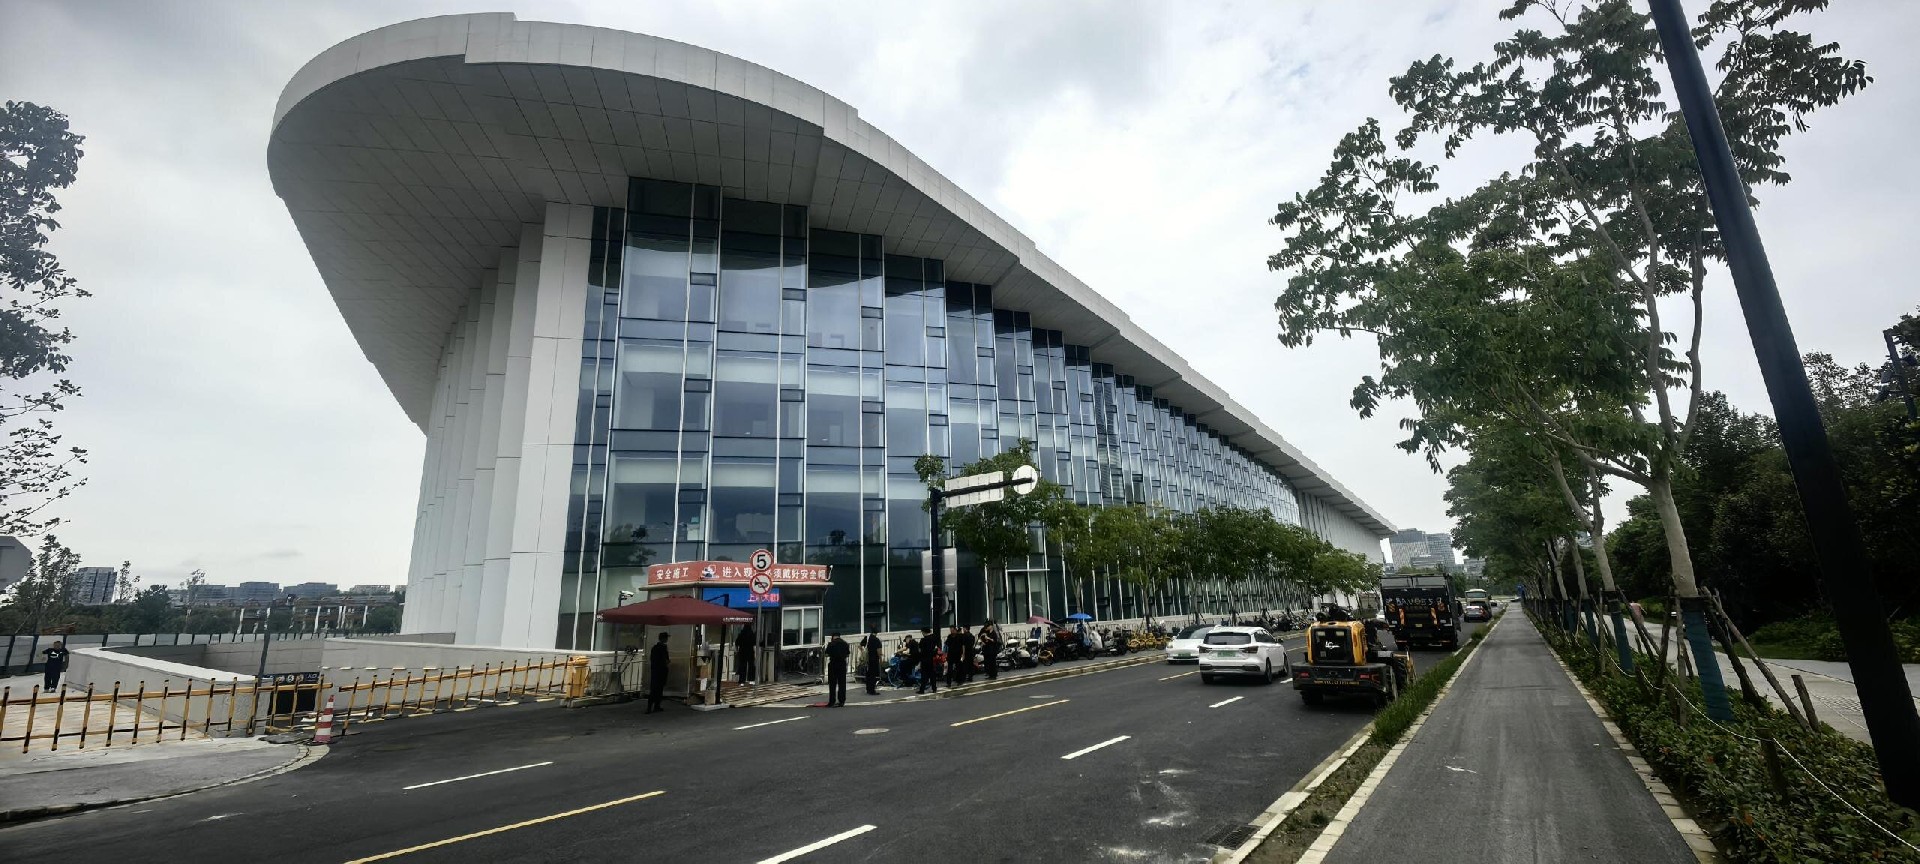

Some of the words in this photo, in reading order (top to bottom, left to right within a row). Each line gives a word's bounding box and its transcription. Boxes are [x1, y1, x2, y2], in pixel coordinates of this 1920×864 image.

[756, 554, 767, 569] 5
[656, 567, 689, 580] 安全施工
